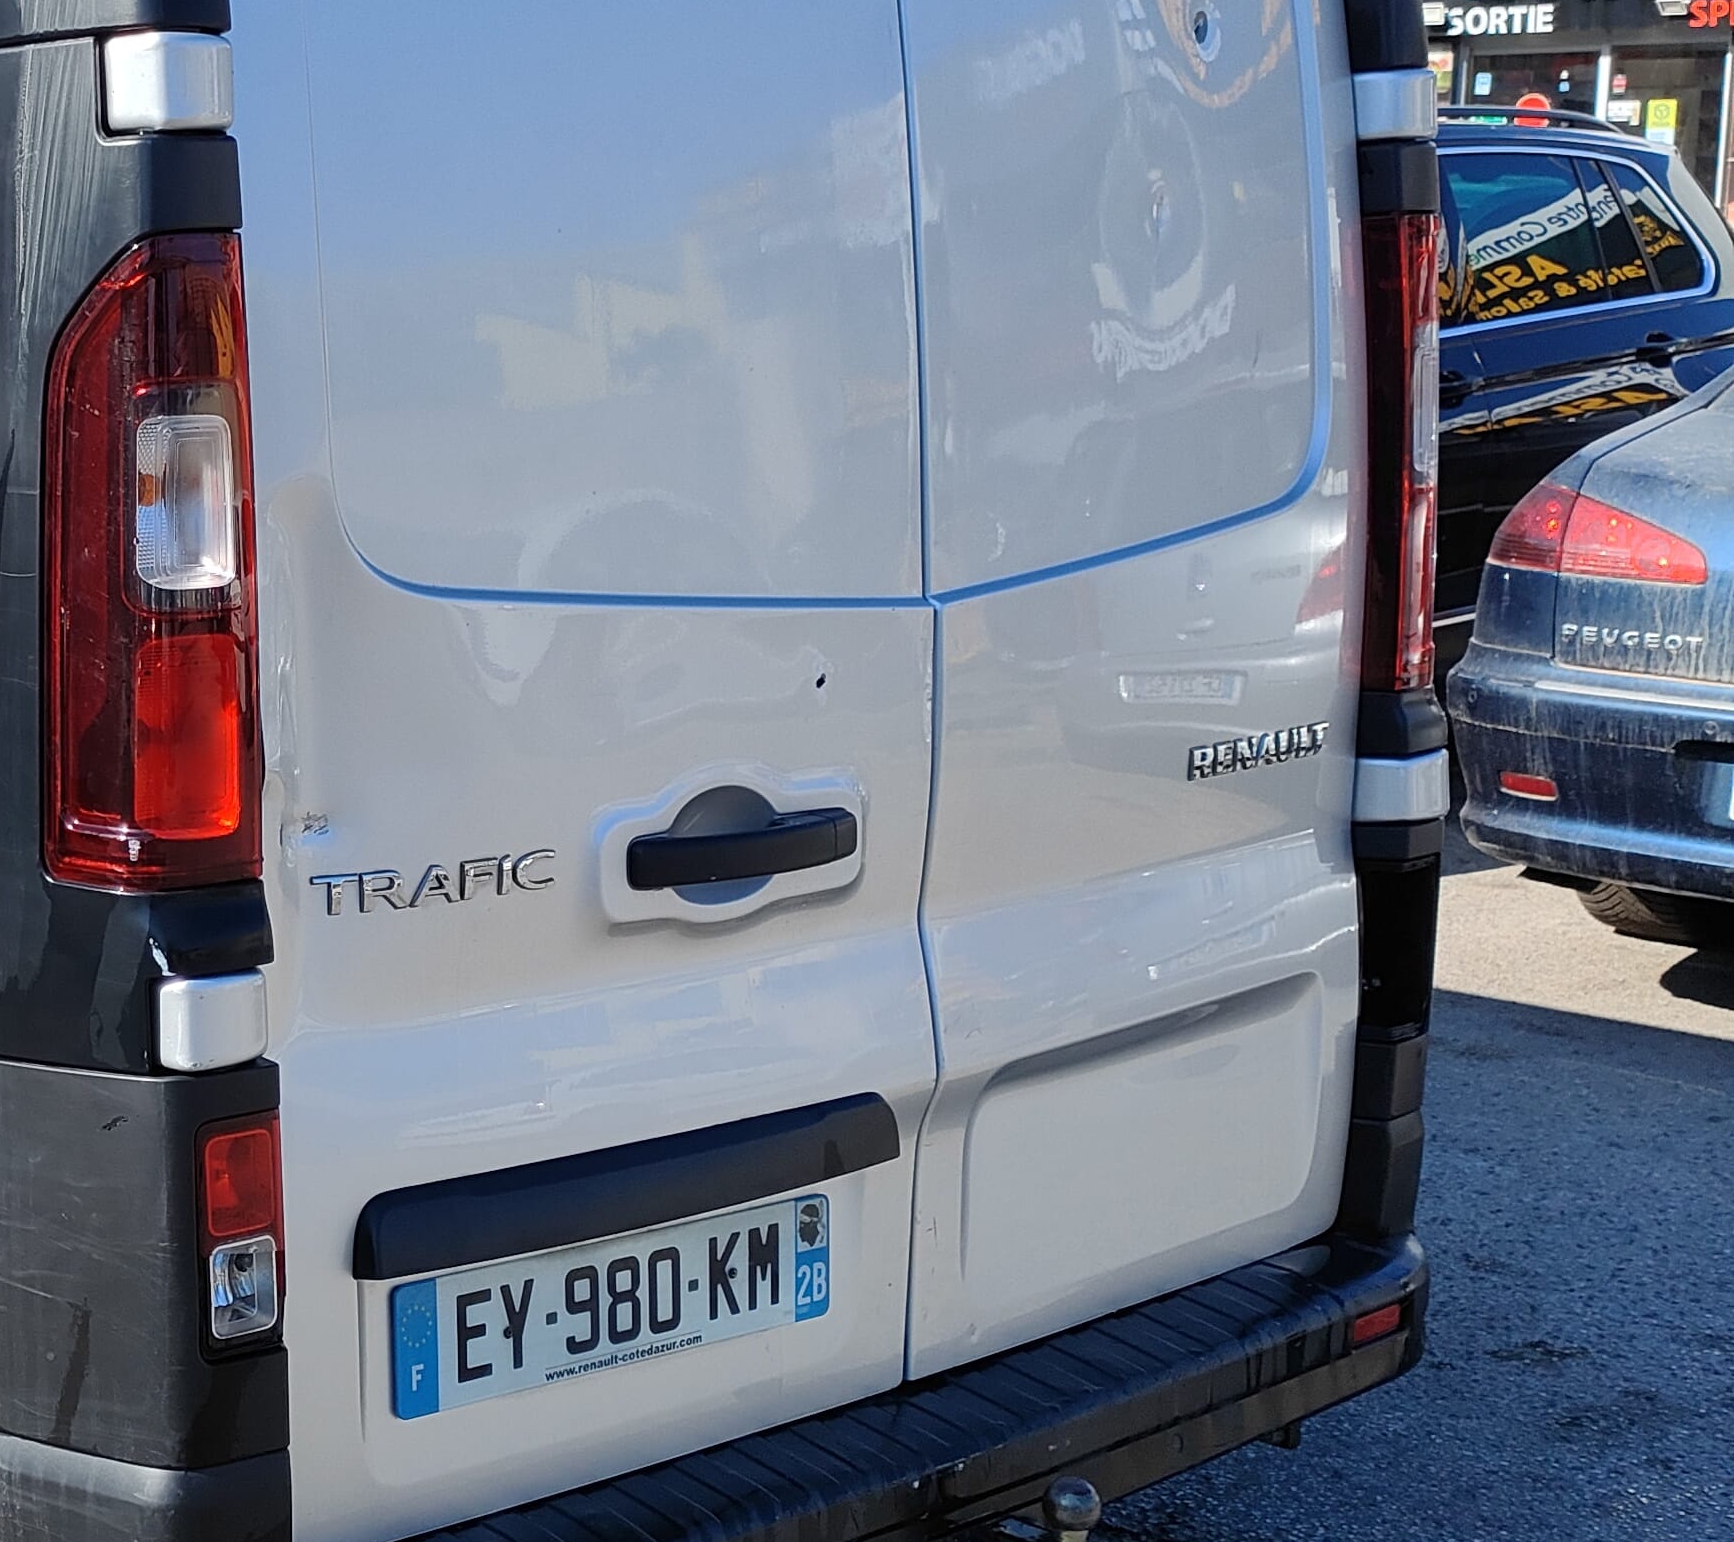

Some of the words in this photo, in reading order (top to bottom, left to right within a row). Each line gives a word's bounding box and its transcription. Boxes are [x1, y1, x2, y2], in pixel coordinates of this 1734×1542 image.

[1446, 2, 1556, 37] SORTIE
[1561, 623, 1705, 651] PEUGEOT
[1186, 720, 1330, 782] RENAULT
[309, 848, 557, 916] TRAFIC
[796, 1260, 828, 1308] 2B
[410, 1363, 426, 1393] F
[544, 1333, 704, 1383] www.renault-cotedazur.com
